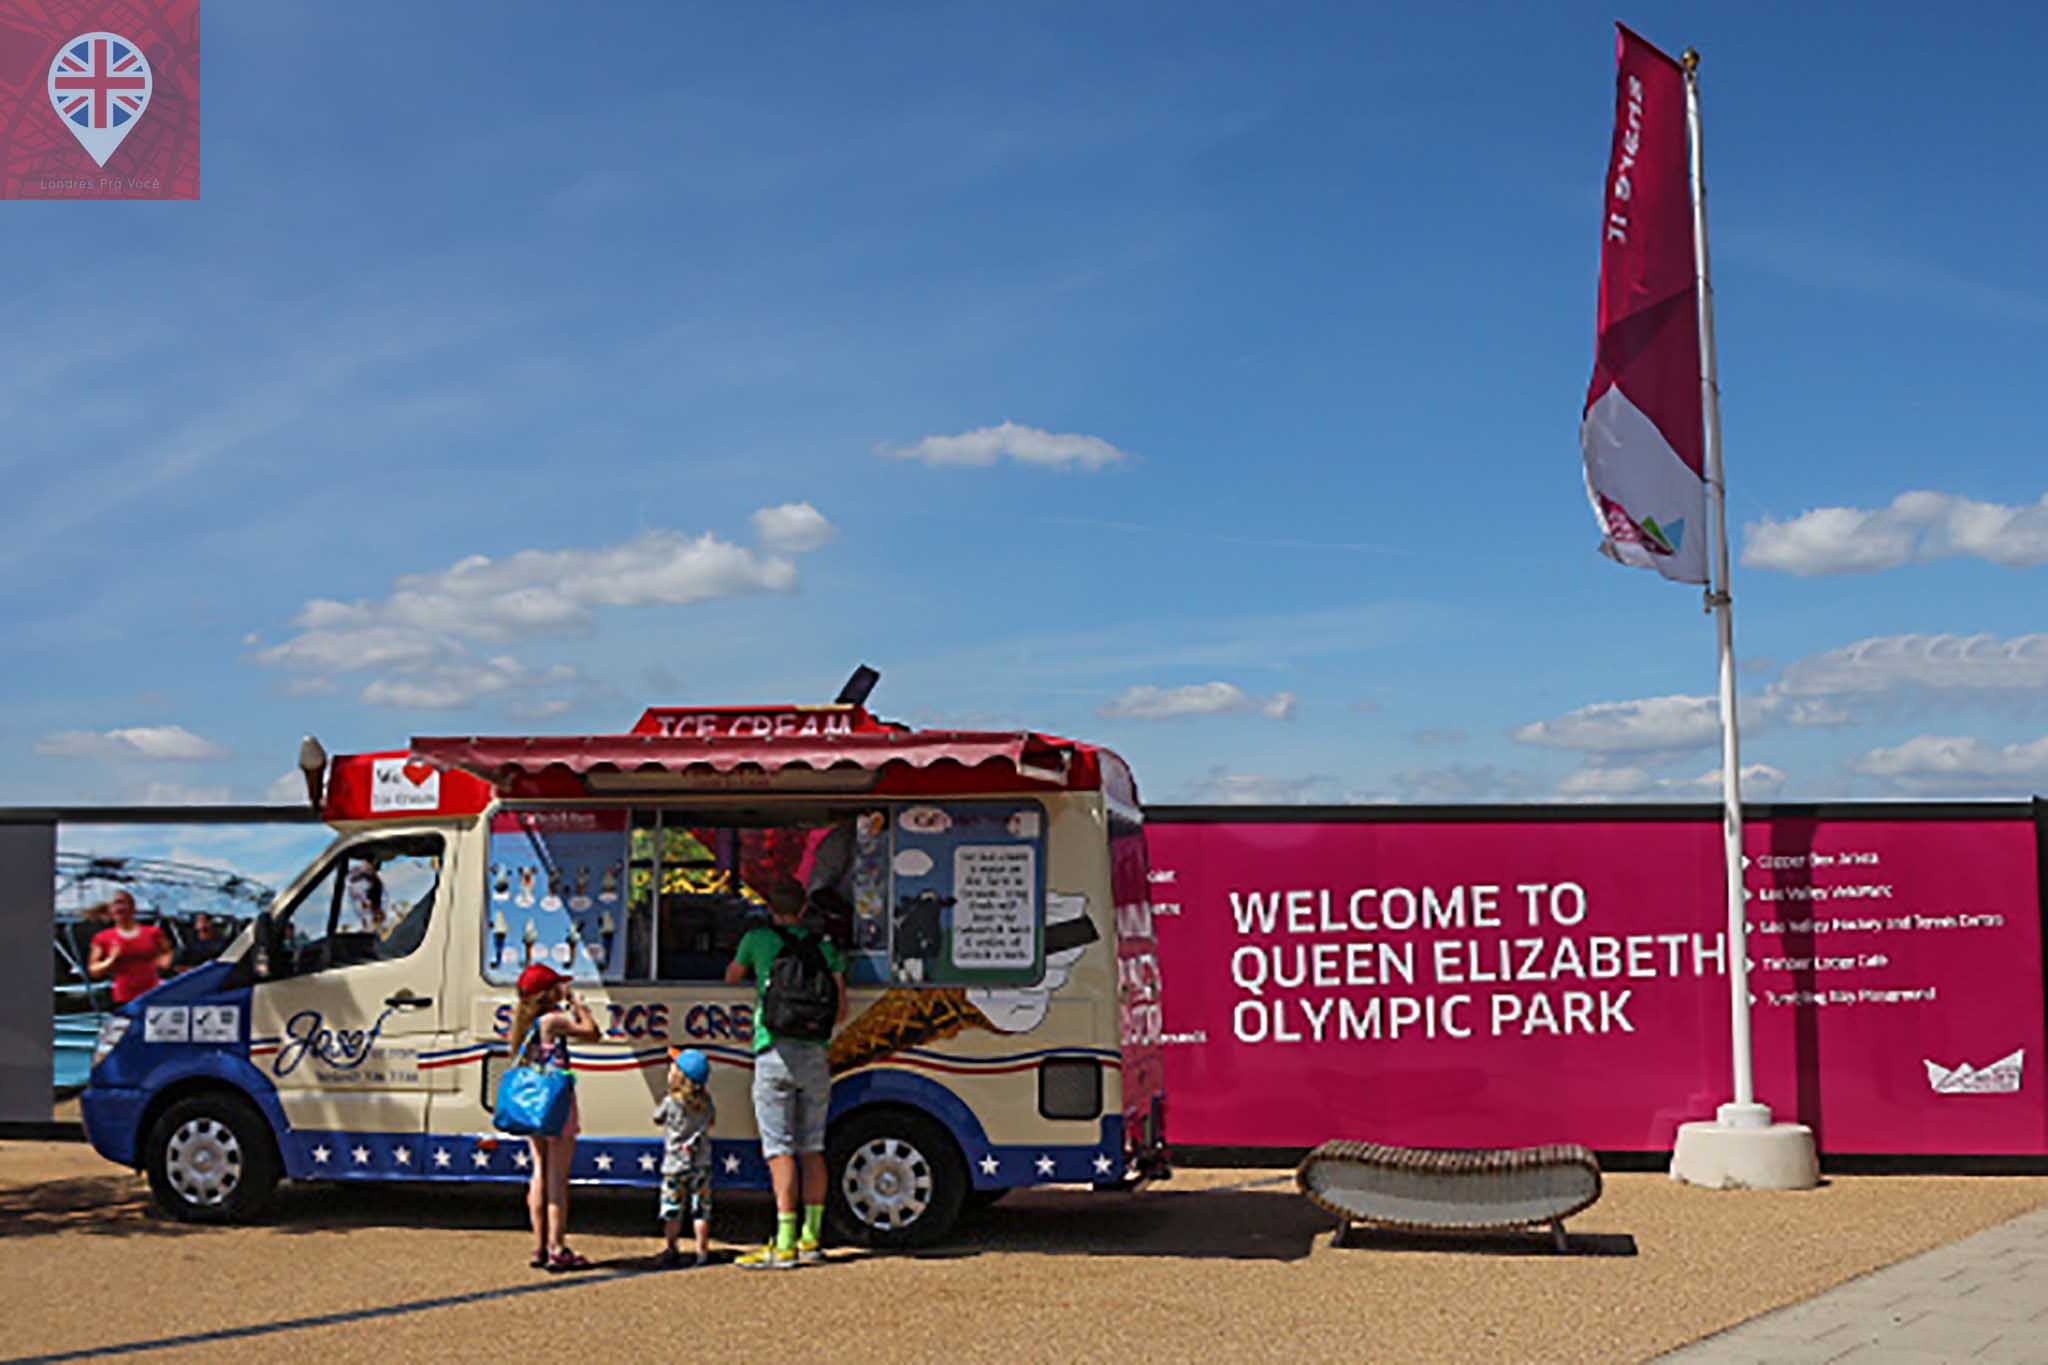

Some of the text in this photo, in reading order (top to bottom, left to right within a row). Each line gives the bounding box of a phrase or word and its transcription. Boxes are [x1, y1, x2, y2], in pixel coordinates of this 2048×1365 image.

[657, 714, 852, 737] ICE CREAM
[1230, 882, 1587, 934] WELCOME TO
[1231, 932, 1727, 995] QUEEN ELIZABETH
[606, 1003, 755, 1041] ICE CRE
[1233, 989, 1635, 1043] OLYMPIC PARK
